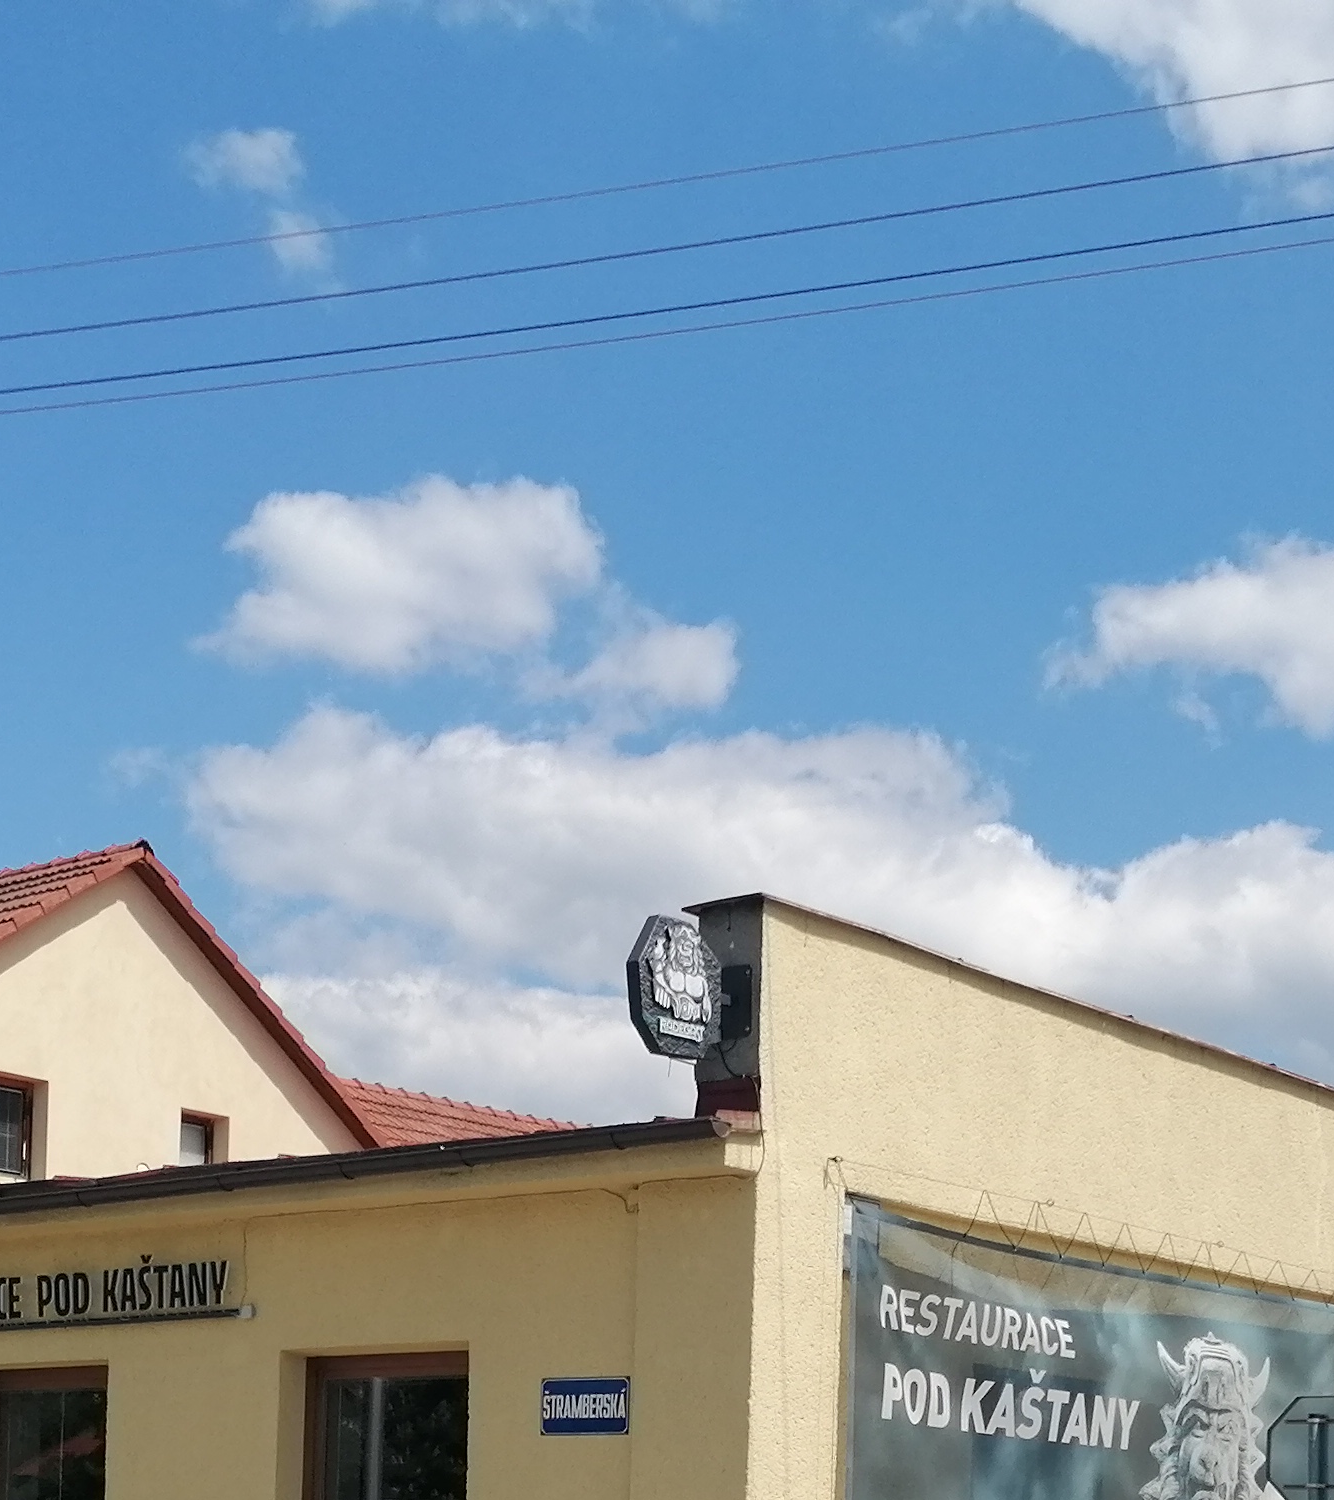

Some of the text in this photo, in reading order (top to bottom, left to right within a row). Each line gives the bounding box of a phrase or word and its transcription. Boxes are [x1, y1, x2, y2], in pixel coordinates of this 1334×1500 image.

[36, 1272, 90, 1318] POD
[102, 1254, 229, 1313] KAŠTANY
[879, 1284, 1077, 1360] RESTAURACE
[542, 1387, 626, 1419] ŠTRAMBERSKÁ
[881, 1362, 1141, 1452] POD KAŠTANY
